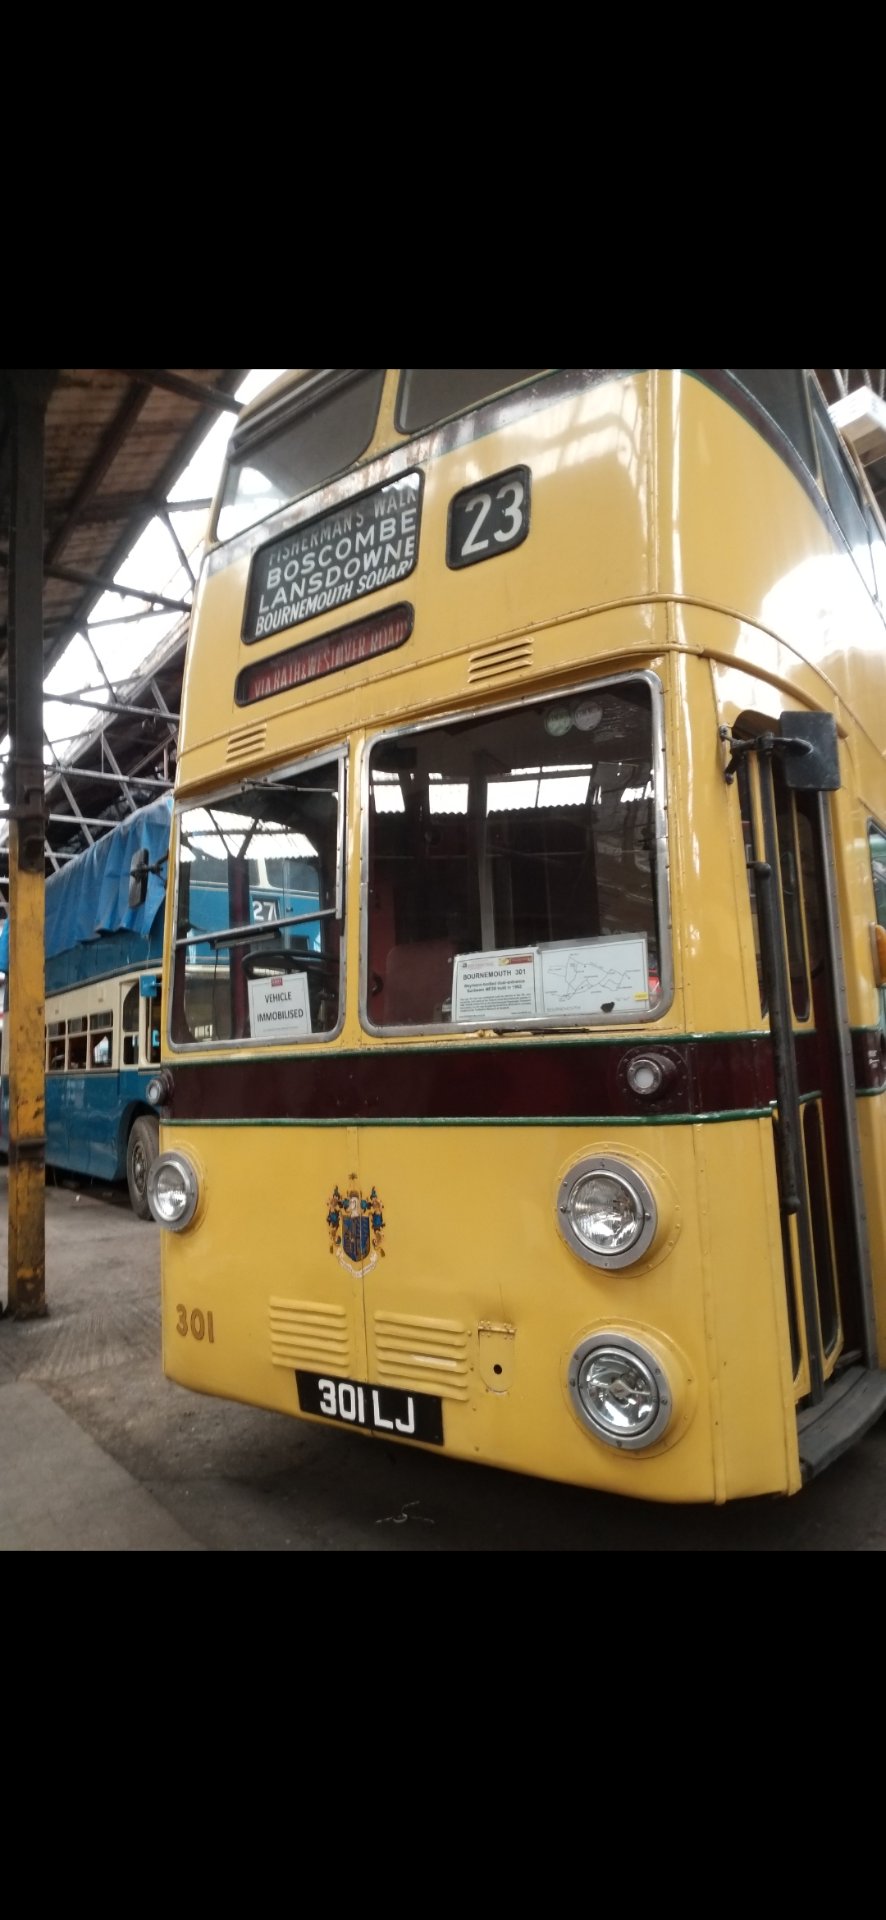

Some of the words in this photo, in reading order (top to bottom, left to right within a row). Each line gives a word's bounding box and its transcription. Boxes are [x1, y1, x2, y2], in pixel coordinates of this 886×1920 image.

[374, 488, 416, 519] WALK
[461, 481, 524, 557] 23
[266, 508, 417, 589] BOSCOMBE
[258, 535, 415, 613] LANSDOWNE
[255, 580, 352, 637] BOURNEMOUTH
[264, 991, 292, 1004] VEHICLE
[462, 969, 512, 981] BOURNEMOUTH
[256, 1008, 304, 1023] IMMOBILISED
[175, 1303, 215, 1344] 301
[317, 1378, 365, 1424] 301
[371, 1389, 415, 1435] LJ
